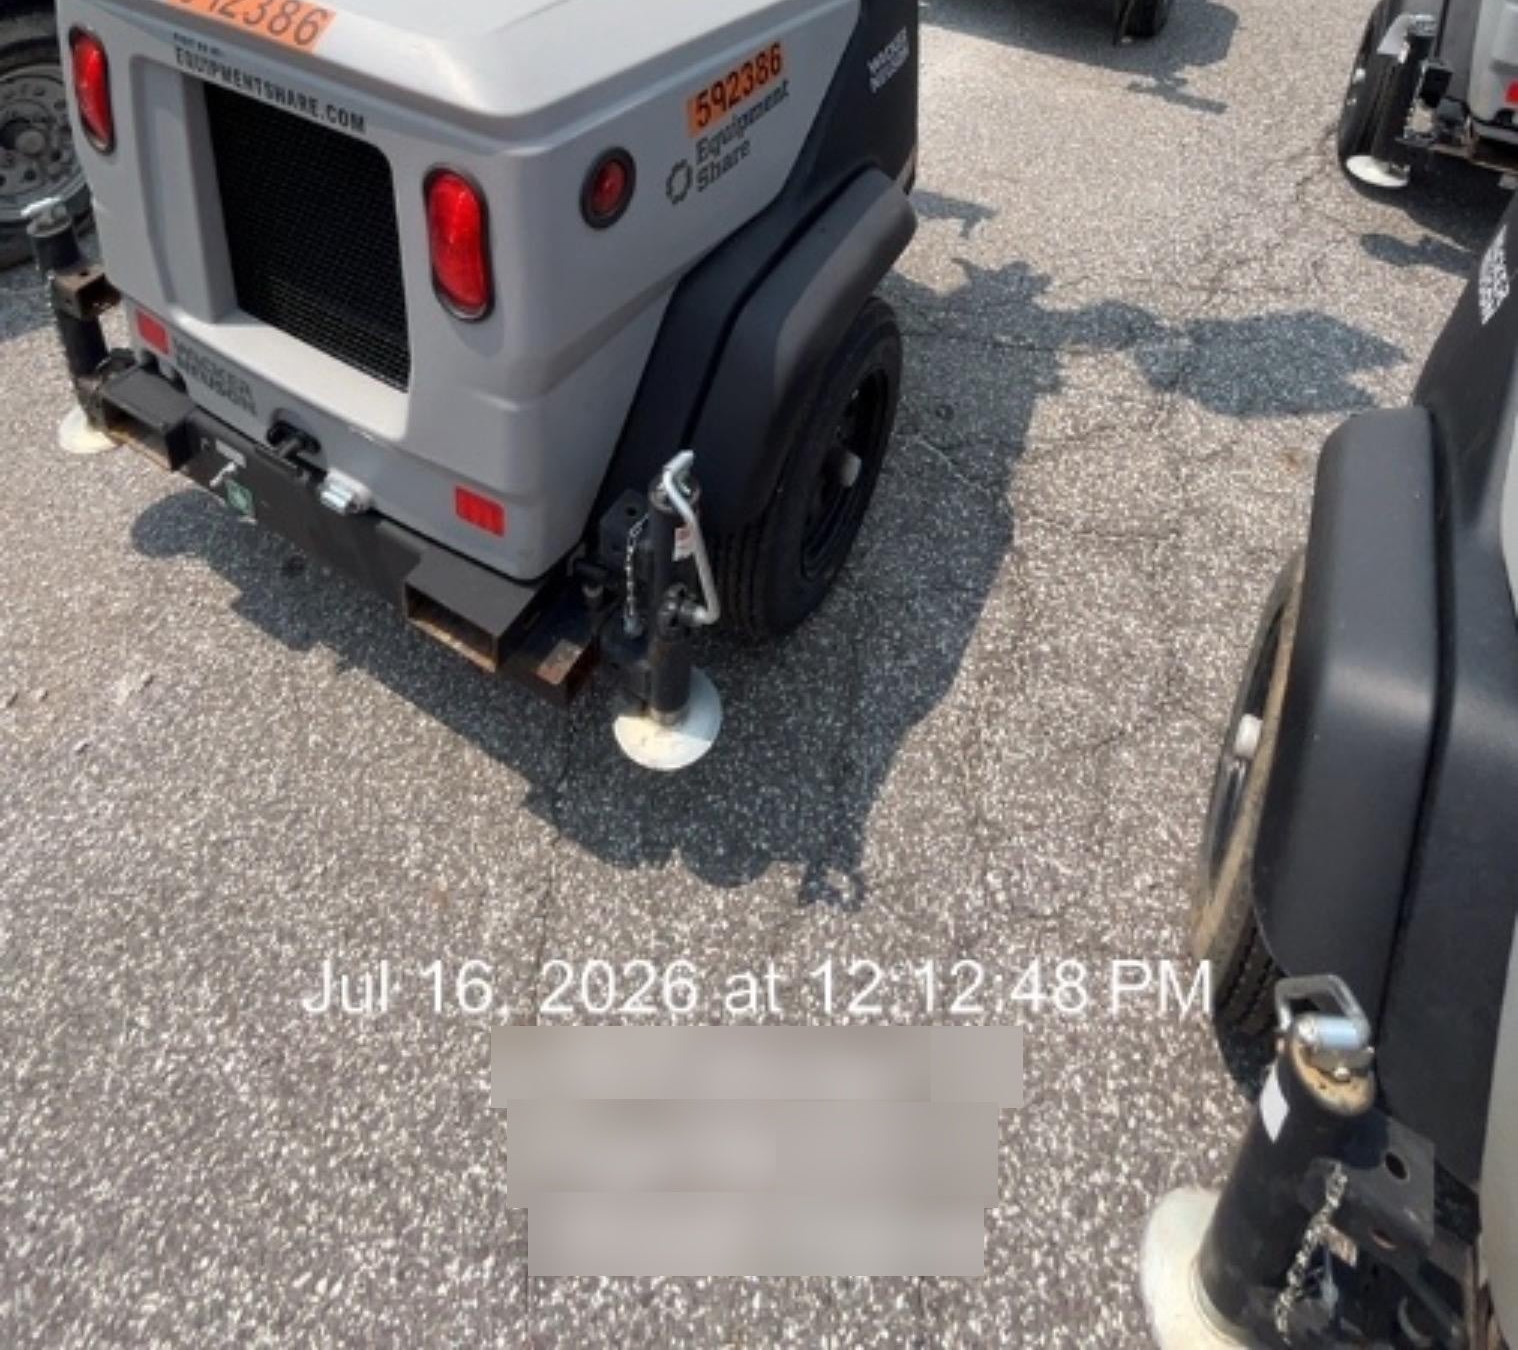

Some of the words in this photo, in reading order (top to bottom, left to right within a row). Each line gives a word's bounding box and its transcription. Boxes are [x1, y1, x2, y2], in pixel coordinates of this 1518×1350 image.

[175, 46, 365, 133] EQUIPMENTSHARE.COM
[695, 41, 781, 128] 592386
[696, 79, 789, 165] Equipment
[696, 139, 751, 192] Share
